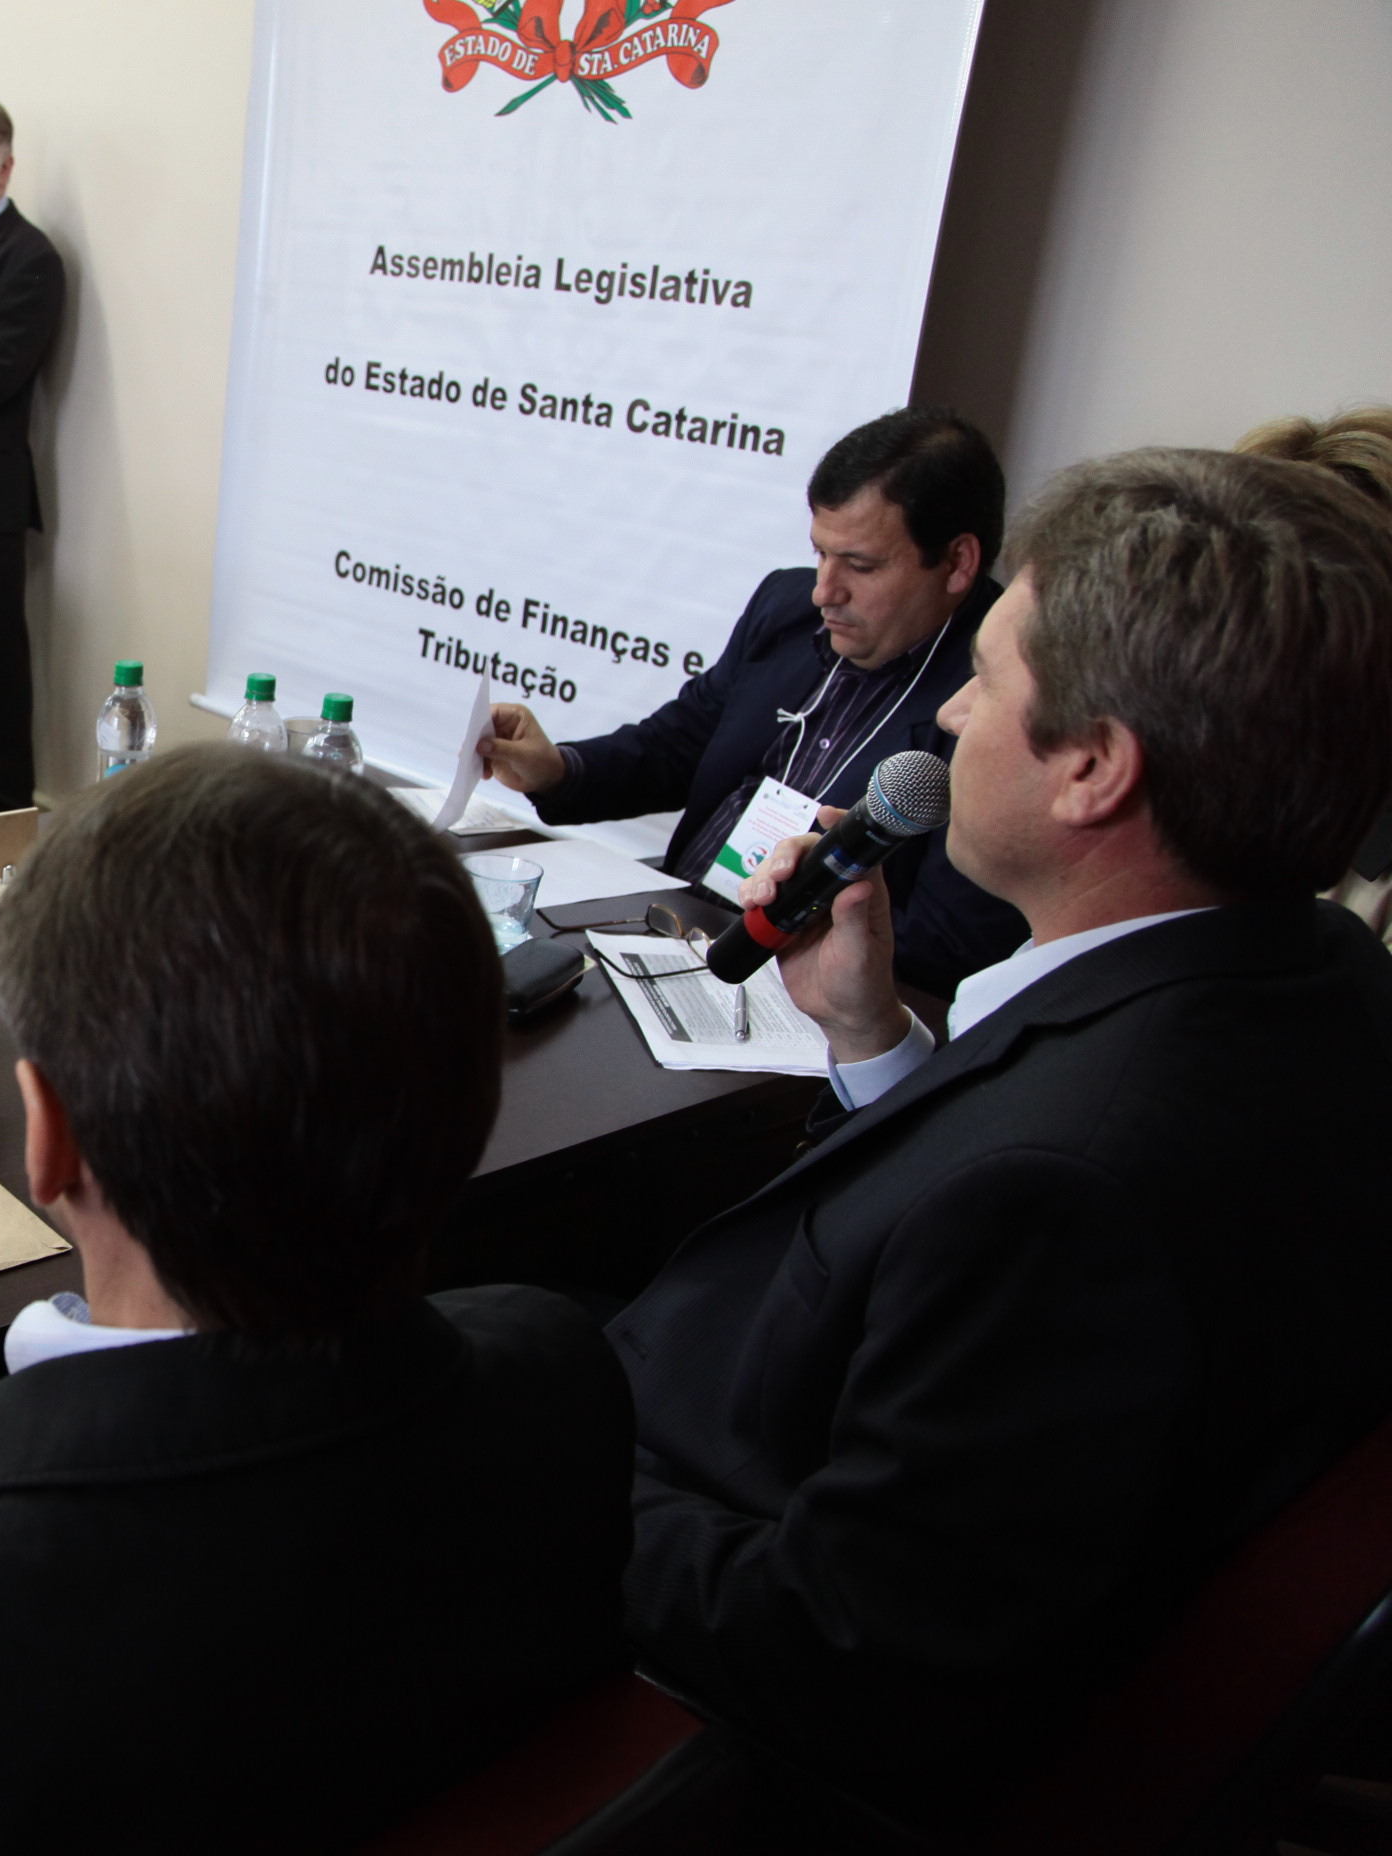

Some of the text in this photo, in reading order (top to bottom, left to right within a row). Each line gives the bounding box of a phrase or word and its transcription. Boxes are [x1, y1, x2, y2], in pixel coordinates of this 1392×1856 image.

[444, 35, 539, 75] ESTADO DE
[578, 23, 710, 76] STA. CATARINA
[370, 245, 754, 308] Assembleia Legislativa
[325, 356, 786, 456] do Estado de Santa Catarina
[334, 549, 705, 677] Comissão de Finanças e
[418, 627, 577, 703] Tributação
